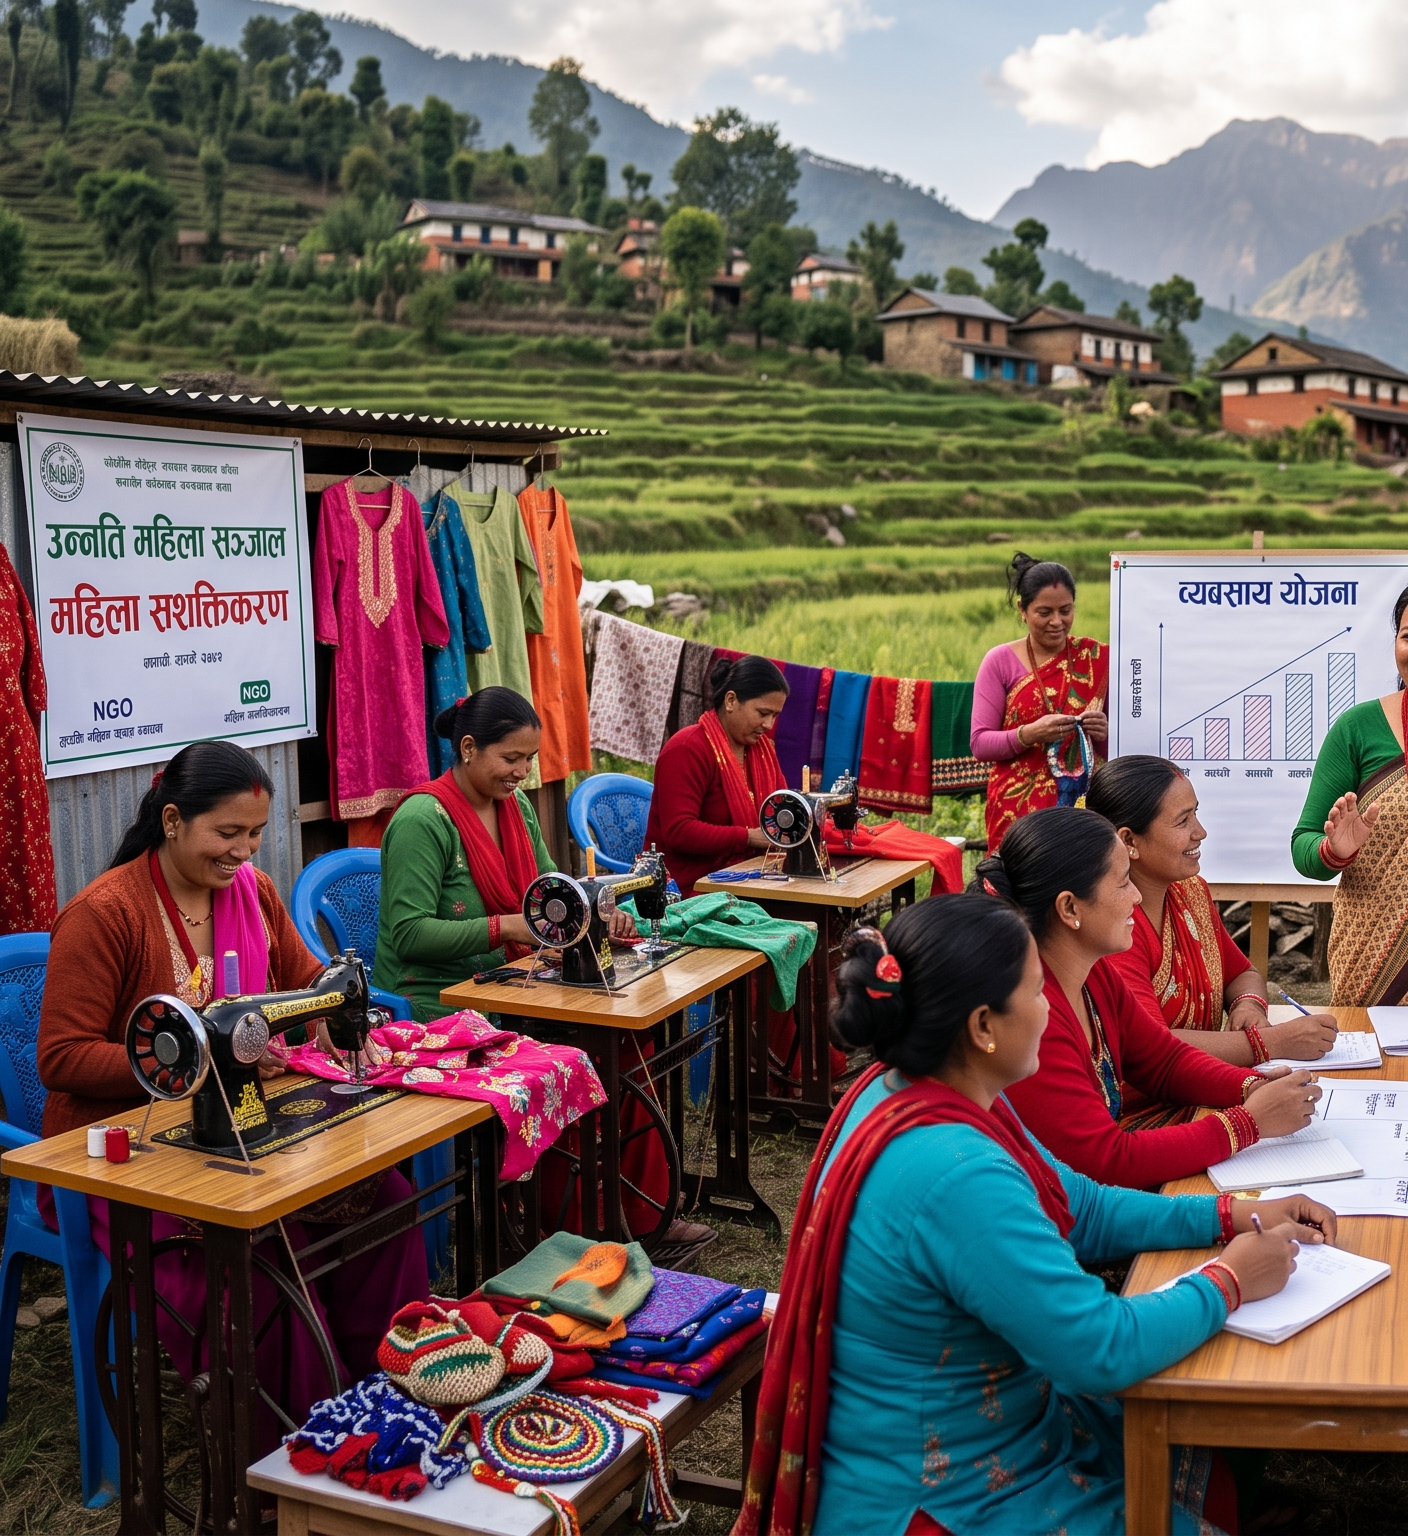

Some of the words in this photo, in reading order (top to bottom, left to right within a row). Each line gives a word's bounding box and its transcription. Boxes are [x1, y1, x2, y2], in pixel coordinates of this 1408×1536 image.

[46, 512, 126, 560] उन्नति
[133, 513, 205, 562] महिला
[211, 526, 287, 560] सञ्जाल
[1280, 573, 1359, 606] योजना
[50, 583, 140, 638] महिला
[149, 580, 289, 633] सशक्तिकरण
[93, 697, 133, 721] NGO
[243, 685, 268, 700] NGO
